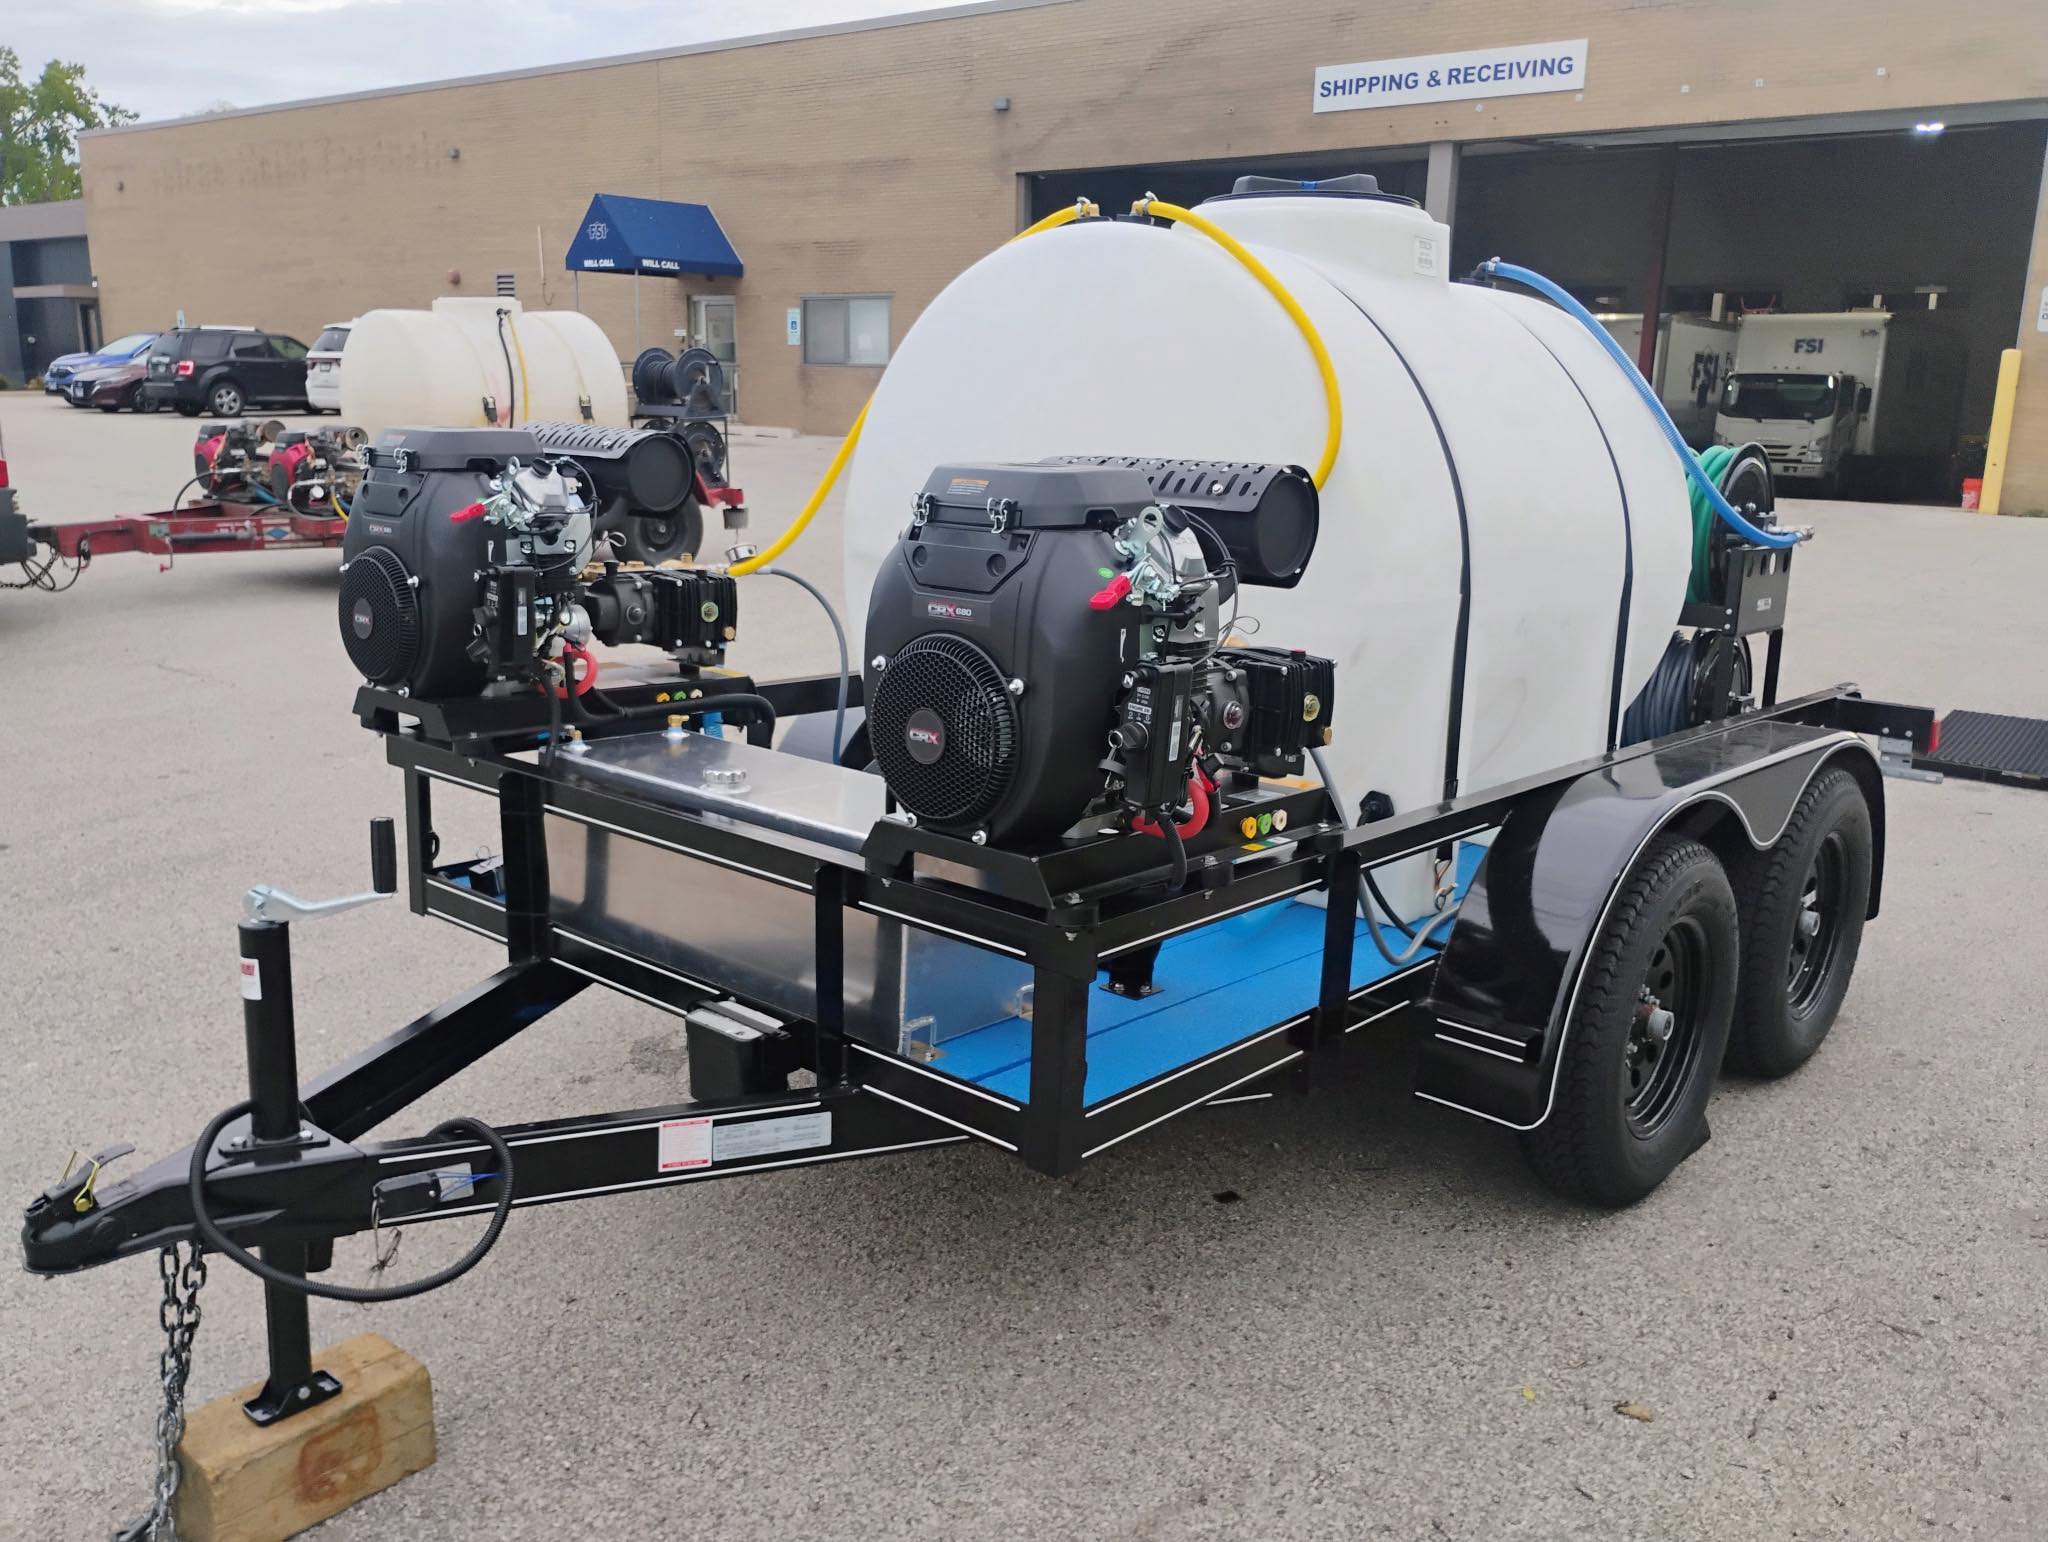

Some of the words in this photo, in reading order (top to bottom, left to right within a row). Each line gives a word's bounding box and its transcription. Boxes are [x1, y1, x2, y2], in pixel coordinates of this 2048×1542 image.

[1320, 72, 1419, 98] SHIPPING
[1427, 70, 1441, 87] &
[1448, 56, 1574, 86] RECEIVING
[588, 222, 608, 240] FSI
[583, 259, 598, 267] WILL
[599, 259, 615, 267] CALL
[642, 259, 660, 268] WILL
[661, 260, 680, 269] CALL
[1794, 339, 1824, 353] FSI
[928, 603, 956, 617] CRX
[910, 729, 939, 745] CRX
